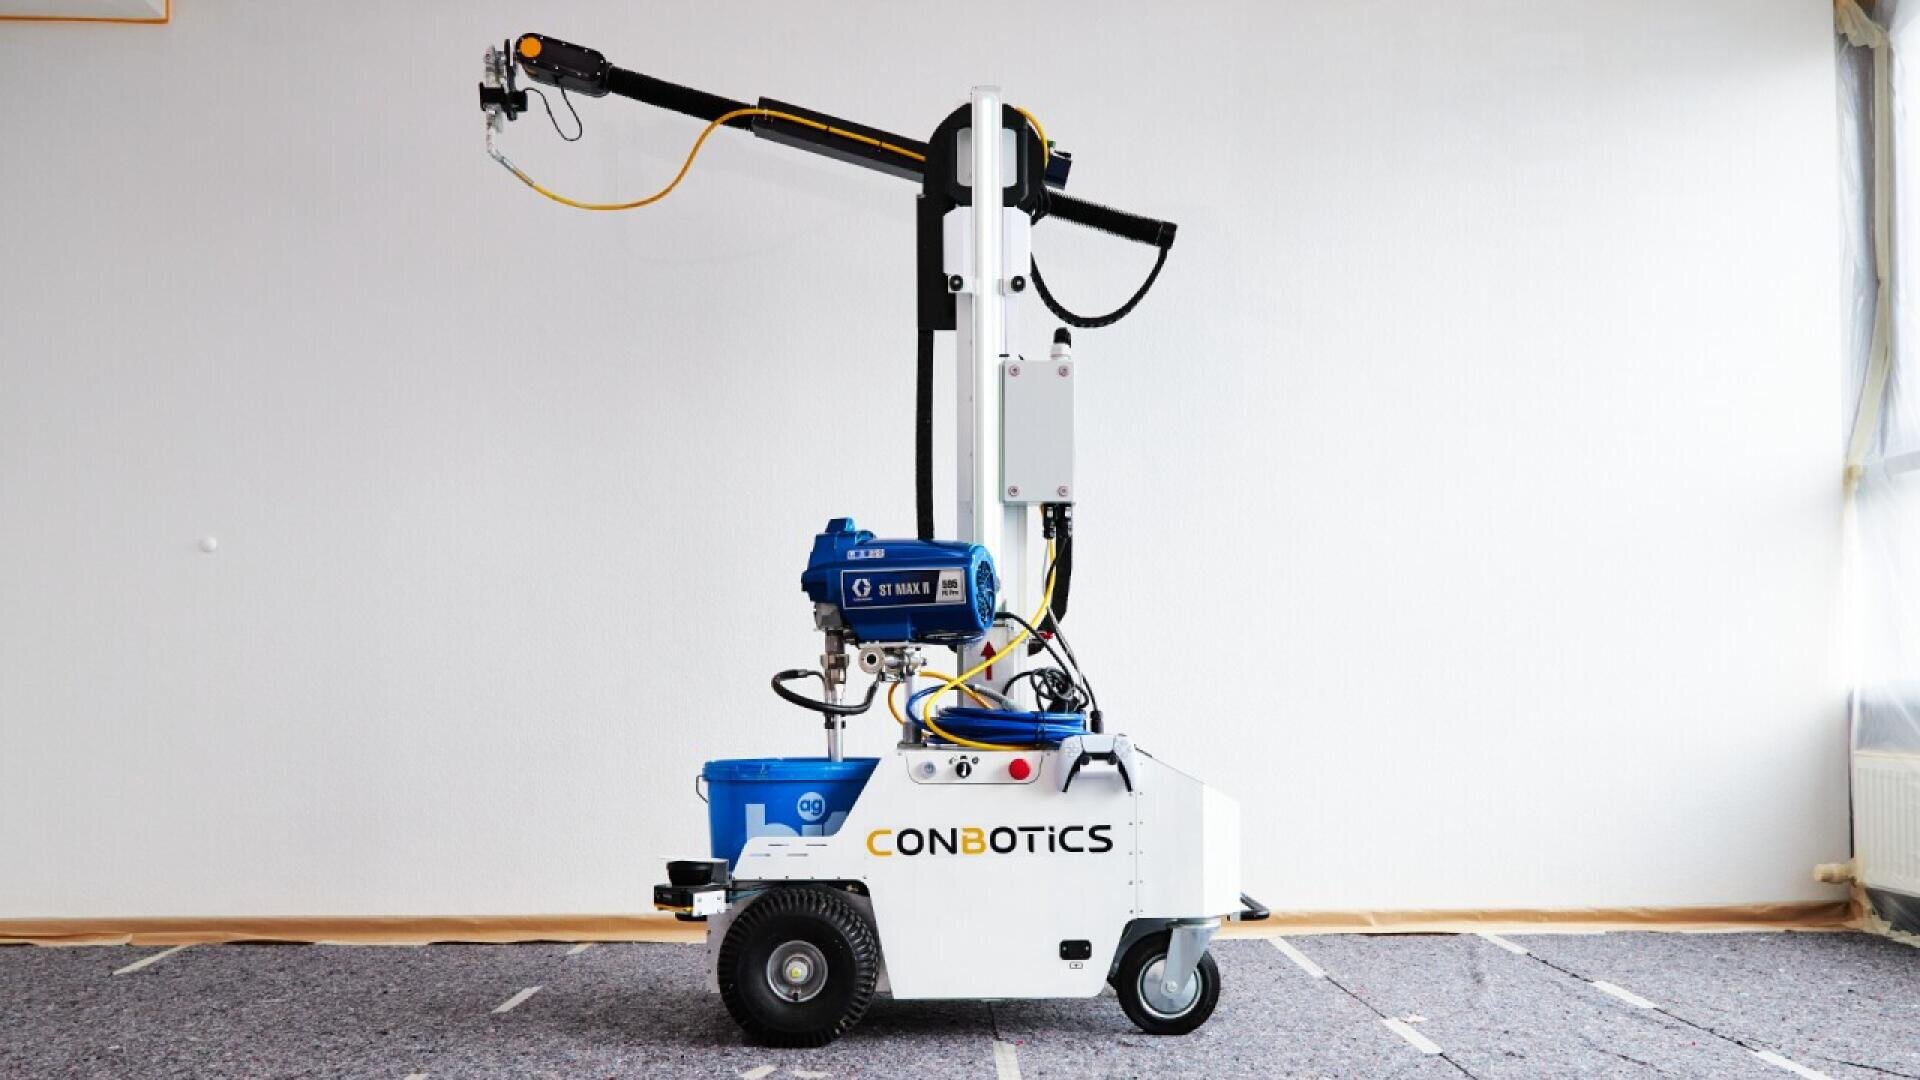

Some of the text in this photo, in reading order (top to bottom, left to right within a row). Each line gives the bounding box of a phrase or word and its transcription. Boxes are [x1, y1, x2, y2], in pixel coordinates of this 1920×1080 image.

[878, 583, 892, 597] ST
[895, 581, 921, 595] MAX
[800, 799, 823, 816] ag
